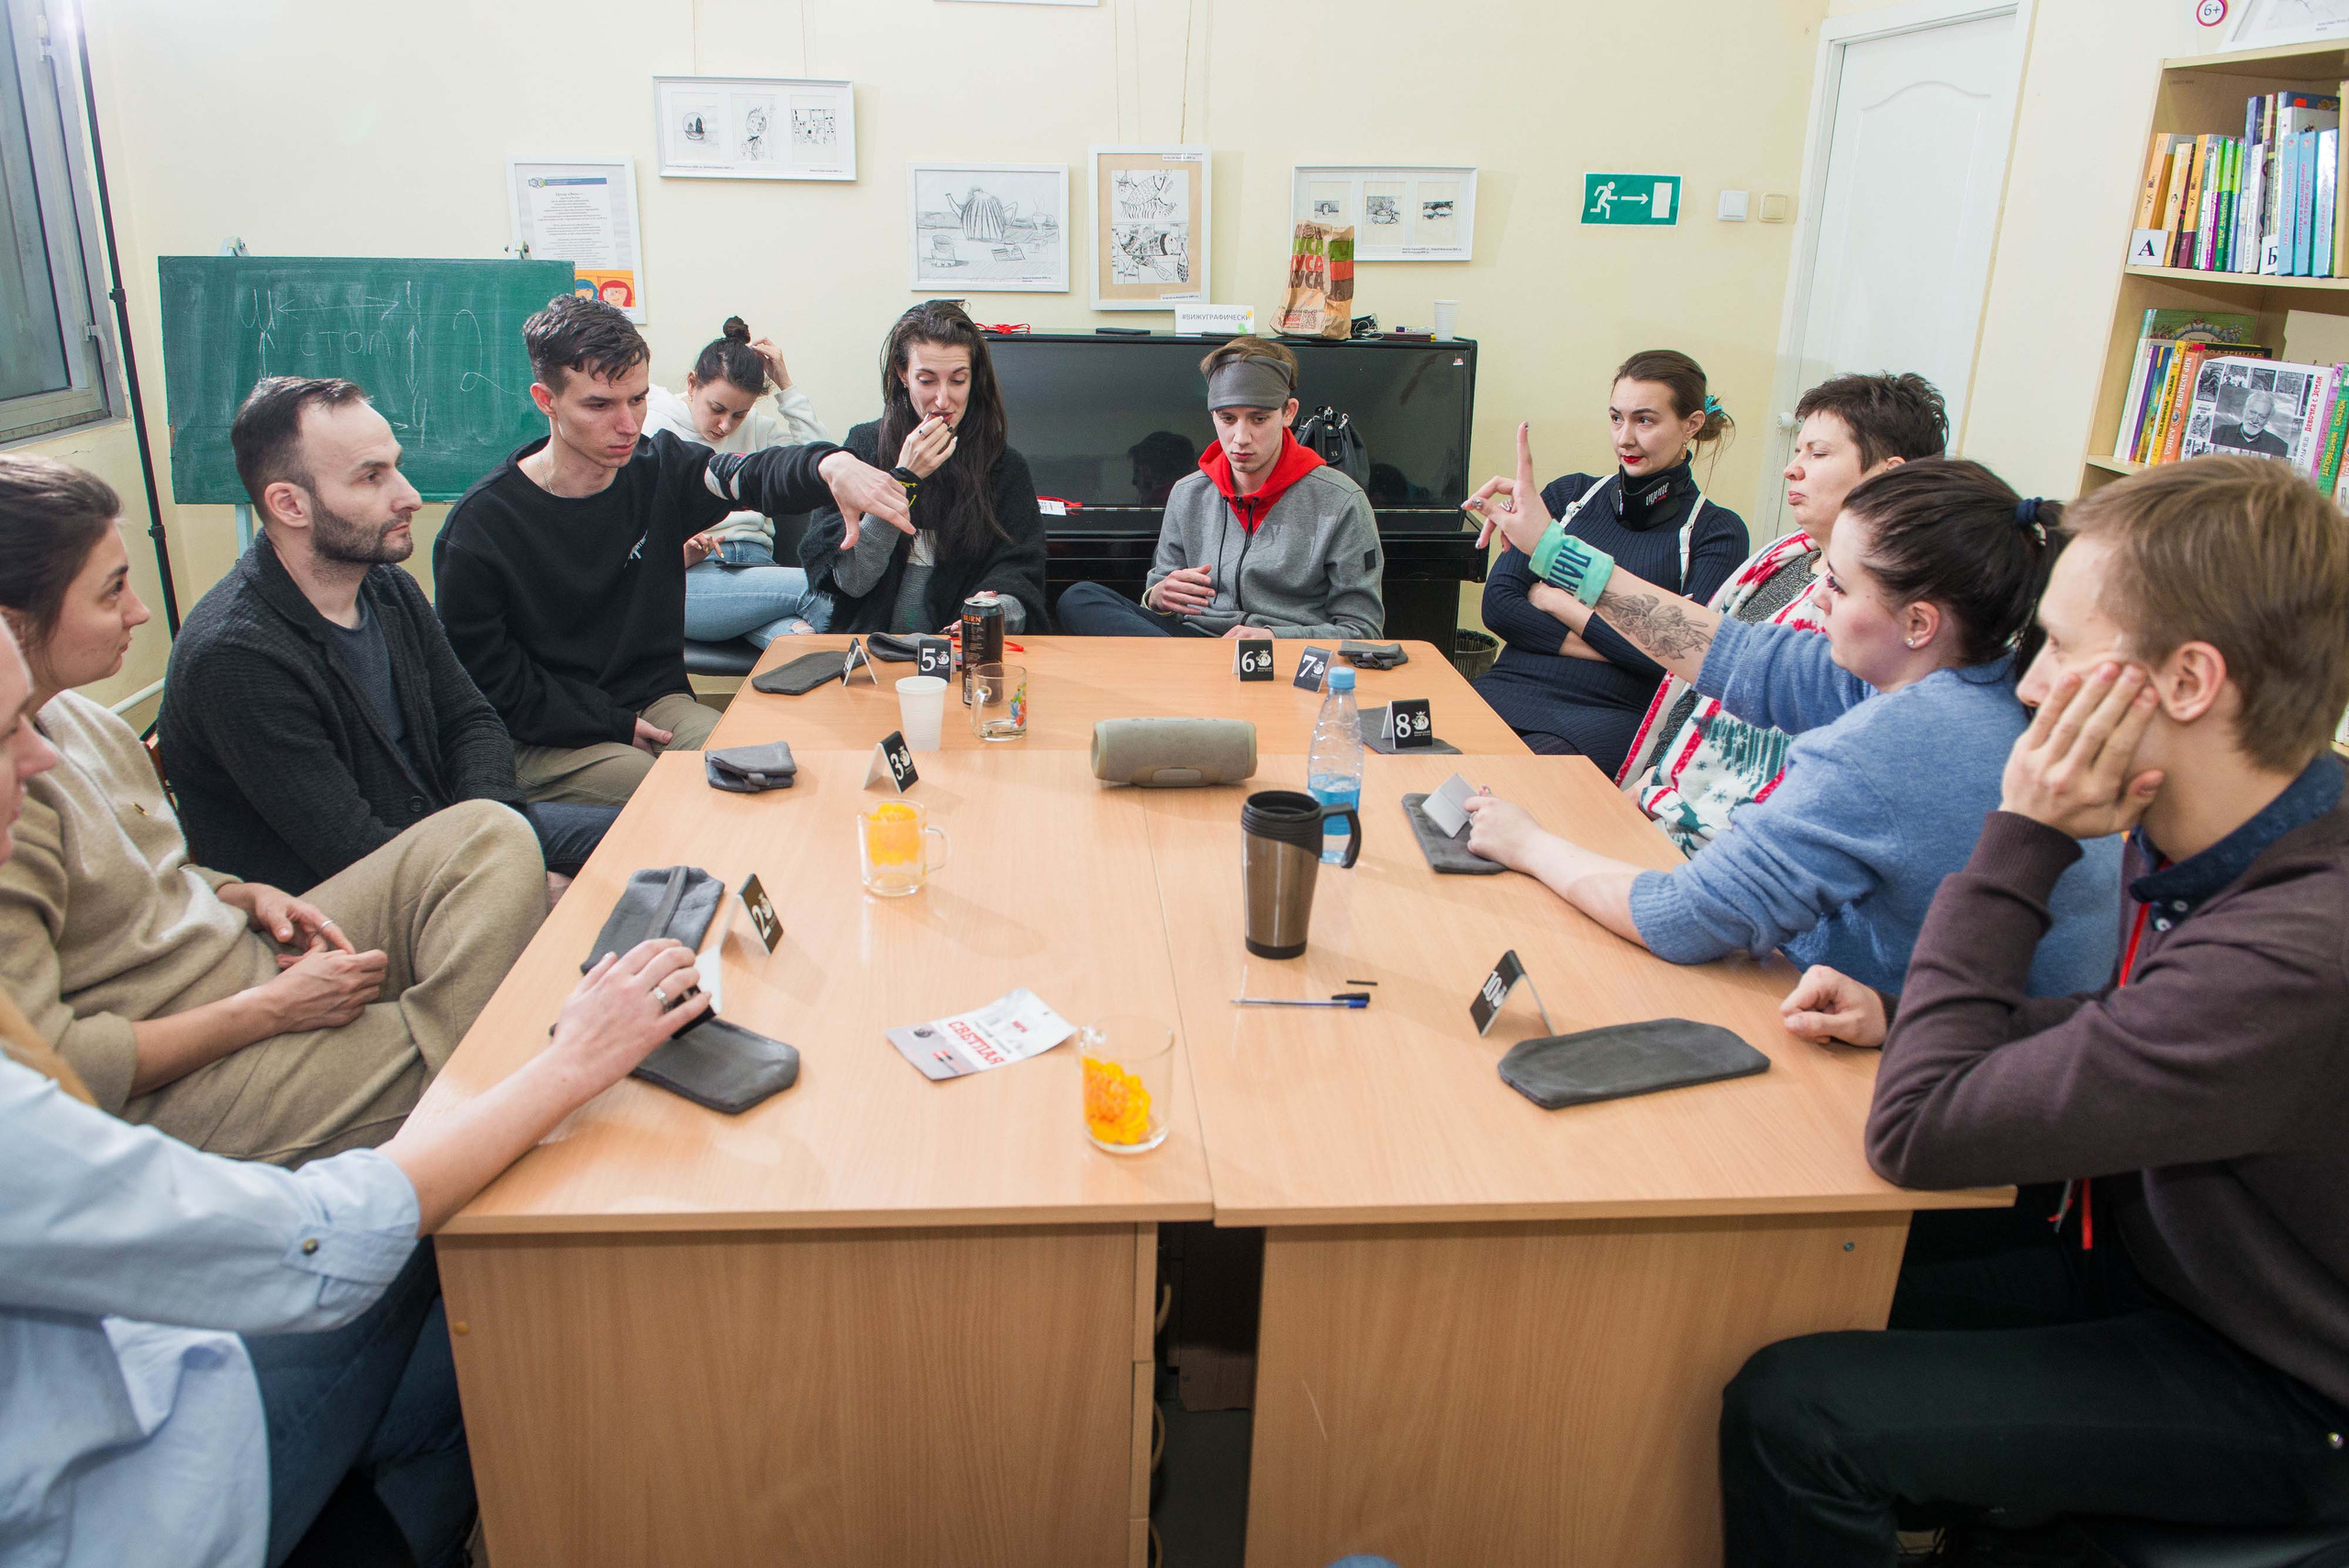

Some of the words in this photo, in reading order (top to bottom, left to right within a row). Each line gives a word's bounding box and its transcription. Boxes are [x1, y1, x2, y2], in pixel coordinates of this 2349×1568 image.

[2204, 4, 2221, 17] 6+
[2138, 239, 2155, 257] А
[2267, 246, 2277, 266] Б
[1182, 313, 1251, 321] #ВИЖУГРАФИЧЕСКИ
[2183, 356, 2191, 372] КИР
[2175, 373, 2188, 408] БУЛЫЧЕВ
[2310, 374, 2322, 397] Земли
[2304, 403, 2317, 432] Девочка
[2164, 427, 2176, 455] АЛИСА
[2321, 430, 2338, 476] ЗАПОВЕДНИК
[2334, 398, 2346, 427] СКАЗОК
[1543, 544, 1592, 596] ПАН
[963, 614, 982, 623] BURN
[920, 648, 936, 672] 5
[1241, 651, 1255, 673] 6
[1298, 654, 1319, 678] 7
[1396, 713, 1411, 739] 8
[890, 752, 905, 781] 3
[751, 904, 772, 940] 2
[1482, 970, 1503, 1002] 10
